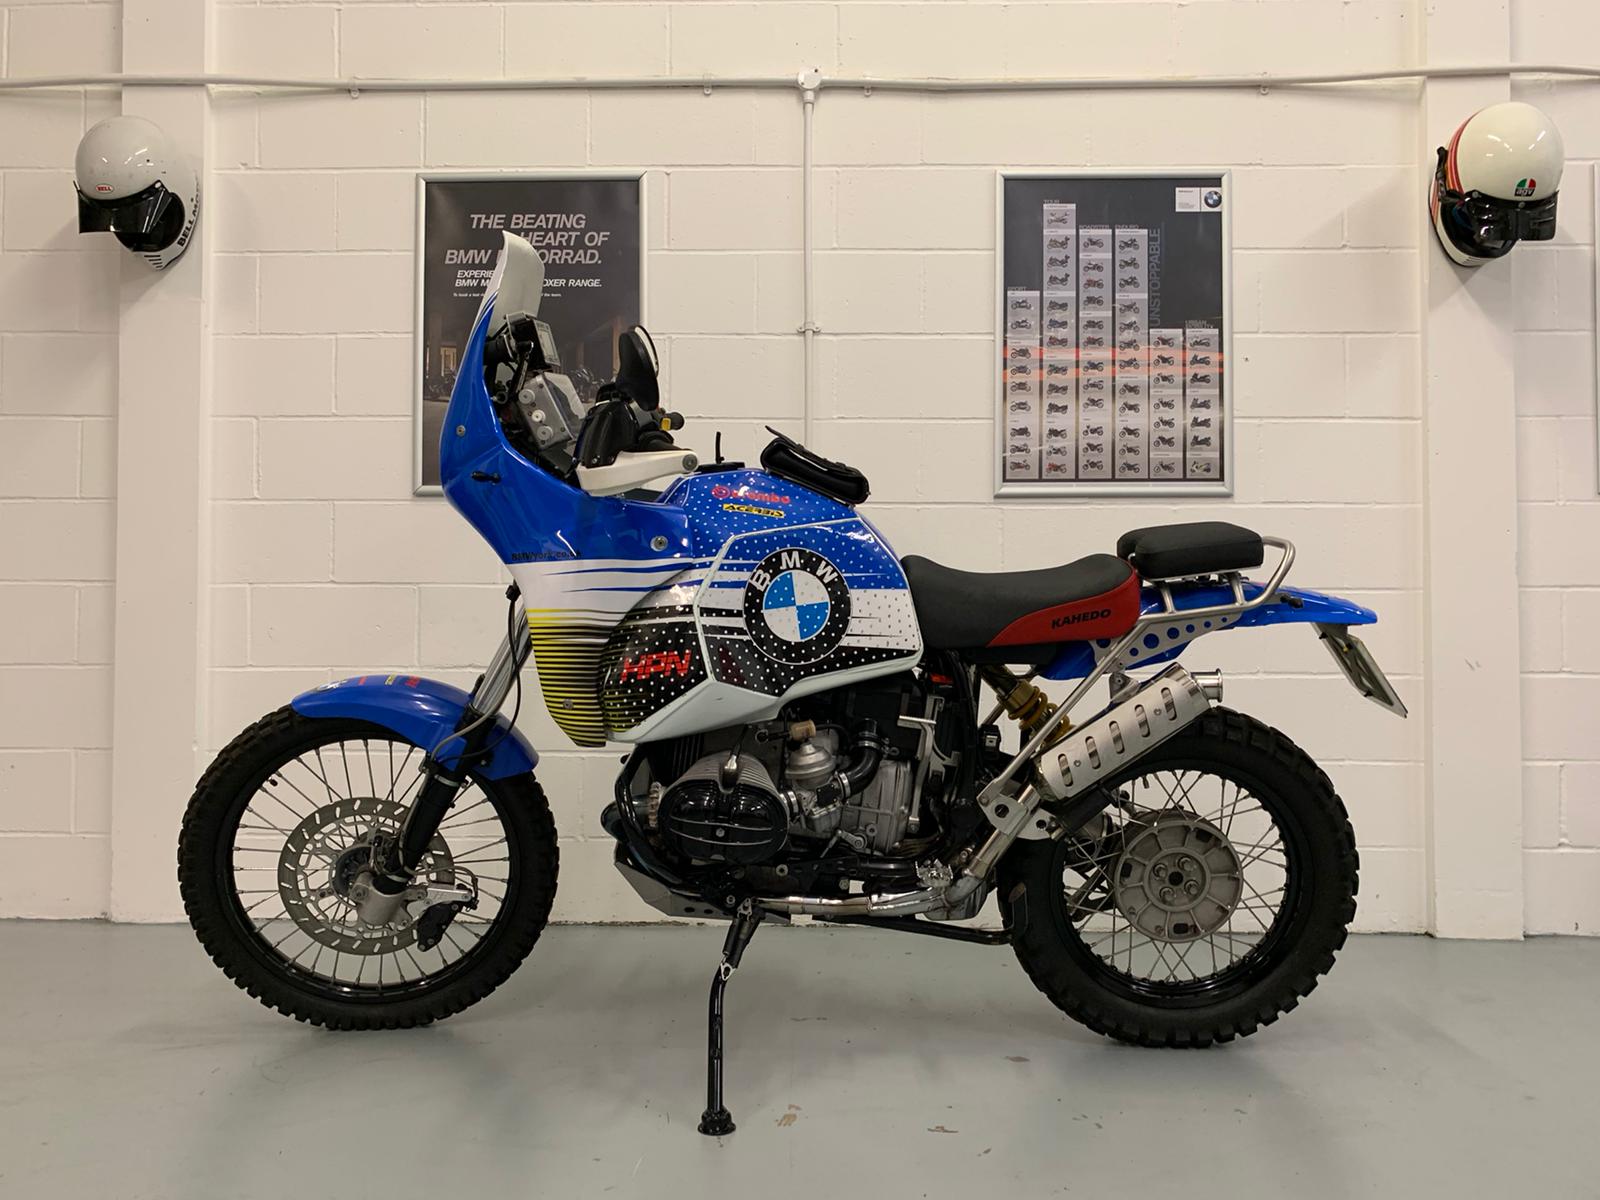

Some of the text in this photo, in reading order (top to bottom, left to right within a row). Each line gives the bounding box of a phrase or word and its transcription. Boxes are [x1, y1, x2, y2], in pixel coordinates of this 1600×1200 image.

[470, 213, 586, 229] THE BEATING
[177, 219, 194, 247] BELL
[584, 231, 610, 246] OF
[444, 249, 492, 264] BMW
[455, 279, 479, 287] BMW
[568, 279, 602, 287] RANGE.
[1149, 229, 1160, 326] UNSTOPPABLE
[749, 551, 838, 592] BMW
[1051, 608, 1112, 629] KAHEDO
